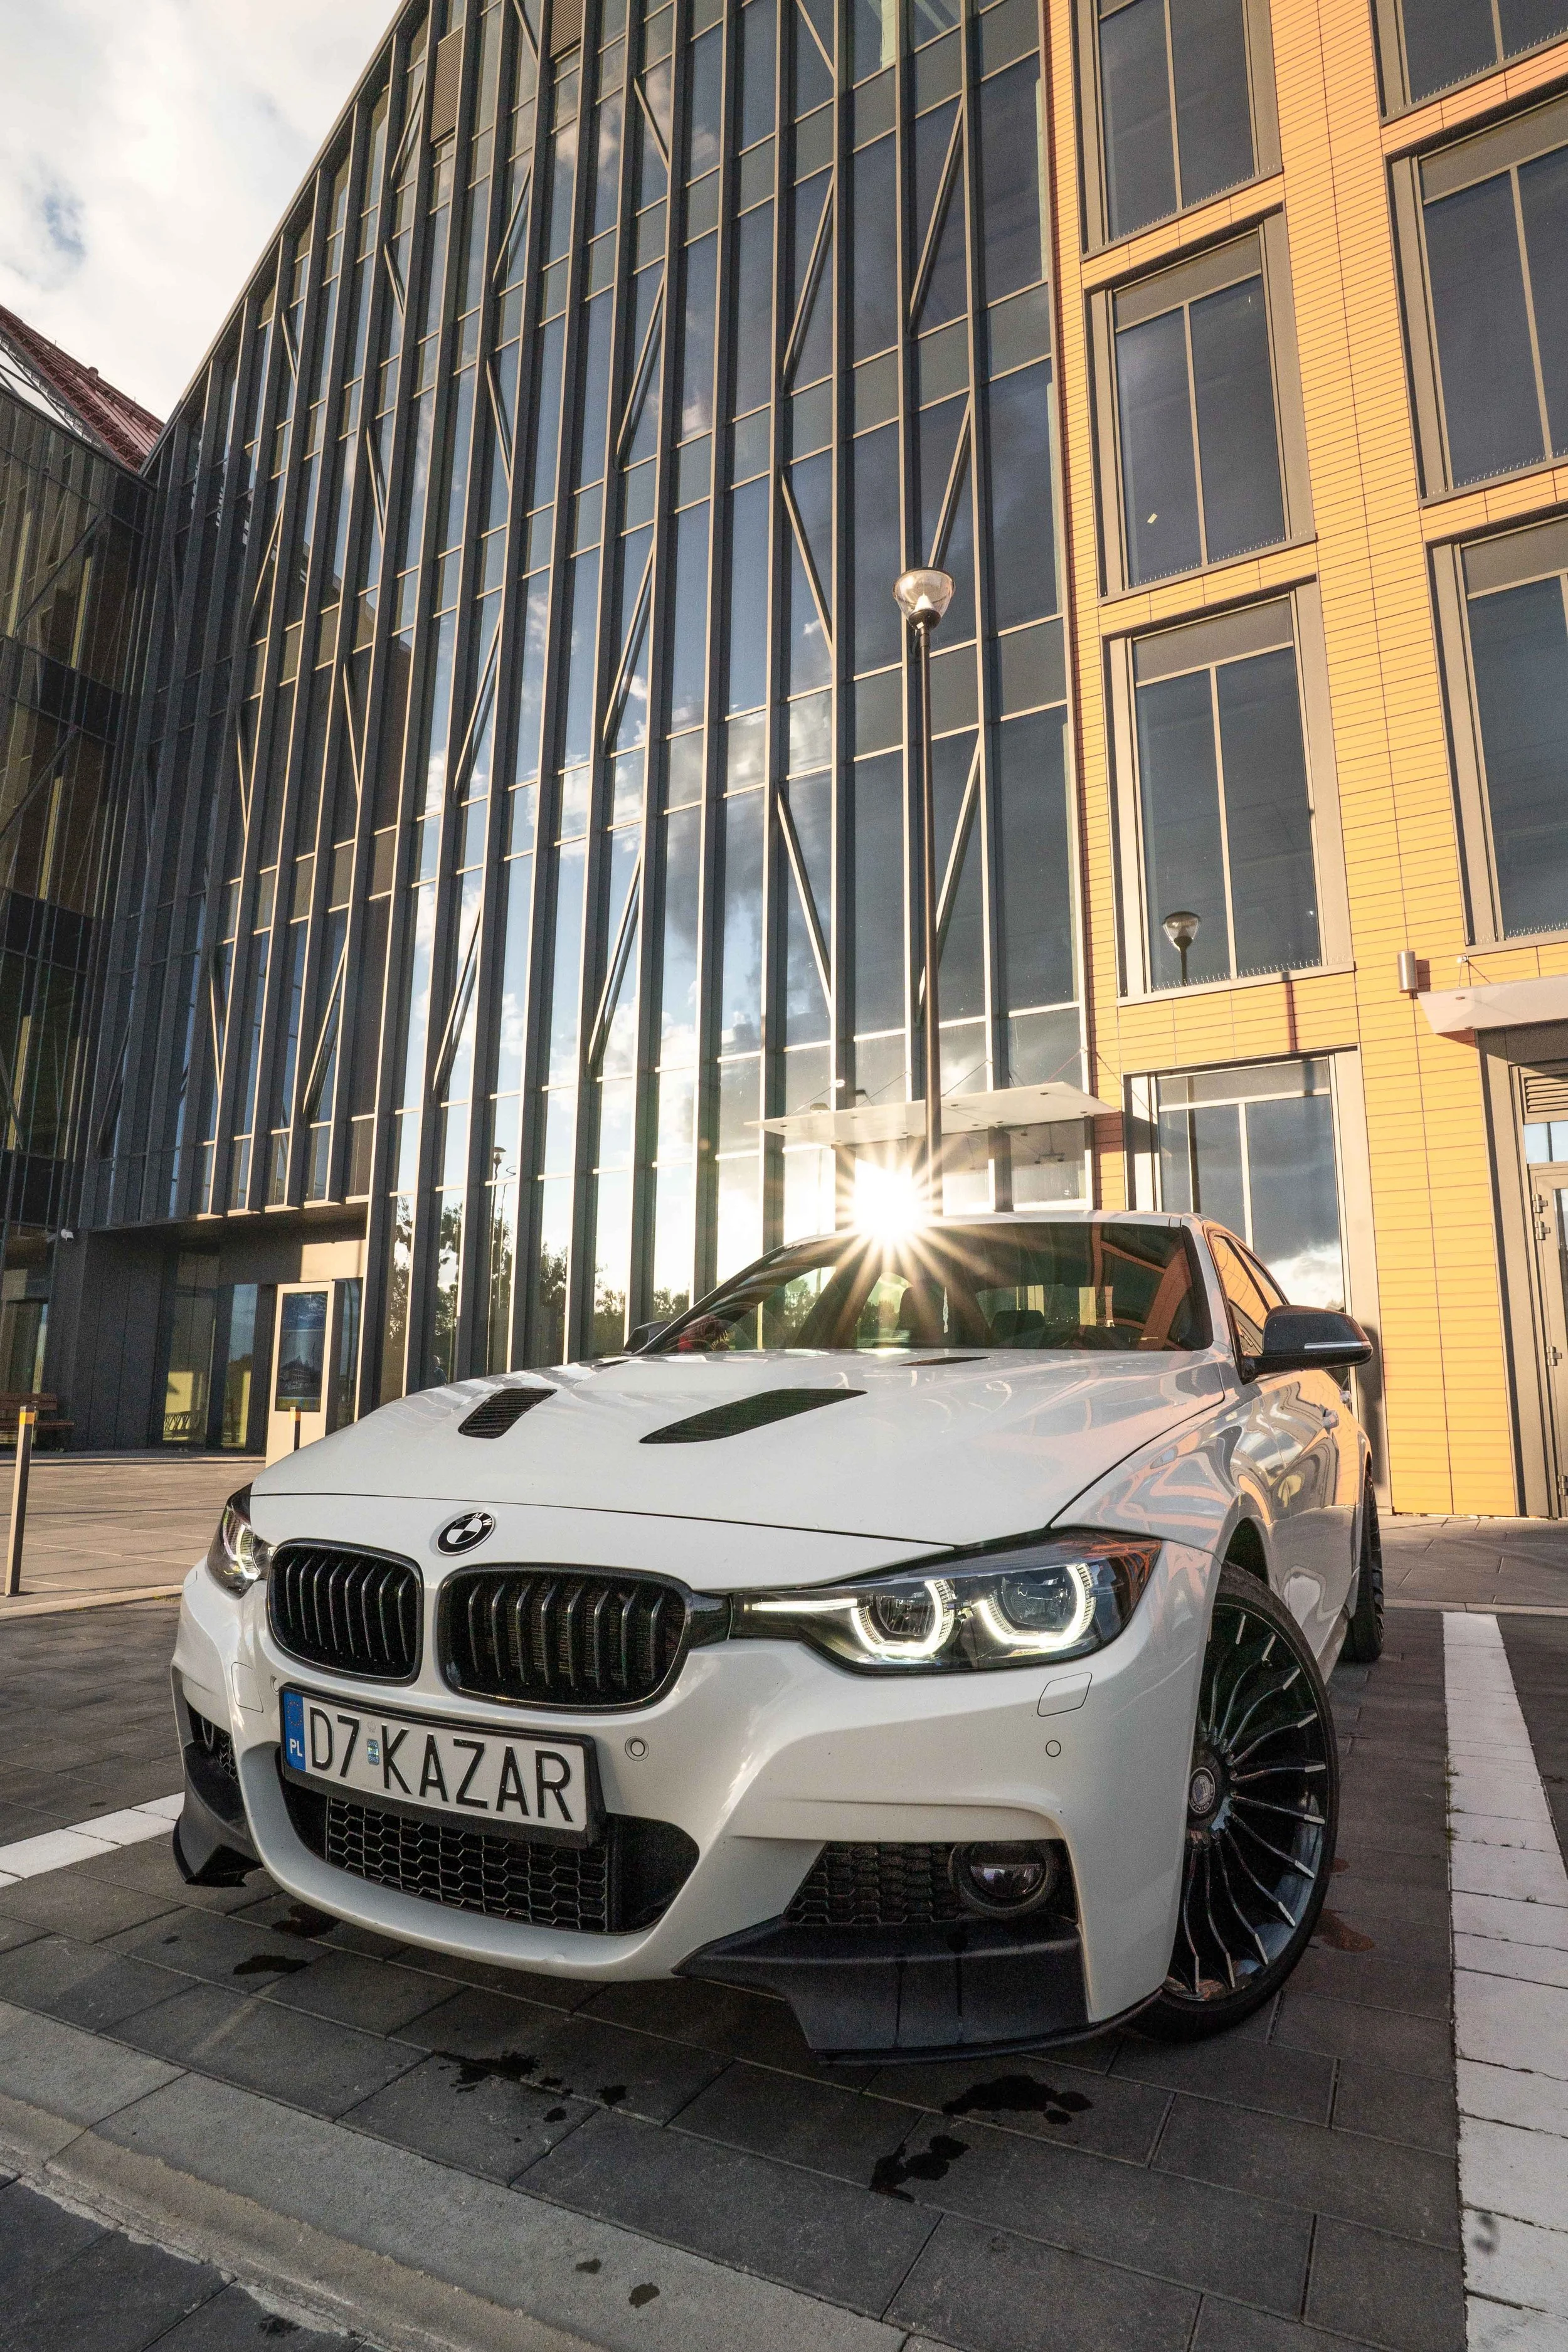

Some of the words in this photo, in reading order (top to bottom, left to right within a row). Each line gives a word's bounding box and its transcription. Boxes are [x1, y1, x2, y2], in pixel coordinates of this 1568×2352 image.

[289, 1738, 302, 1757] PL
[310, 1706, 360, 1777] D7
[381, 1724, 573, 1821] KAZAR
